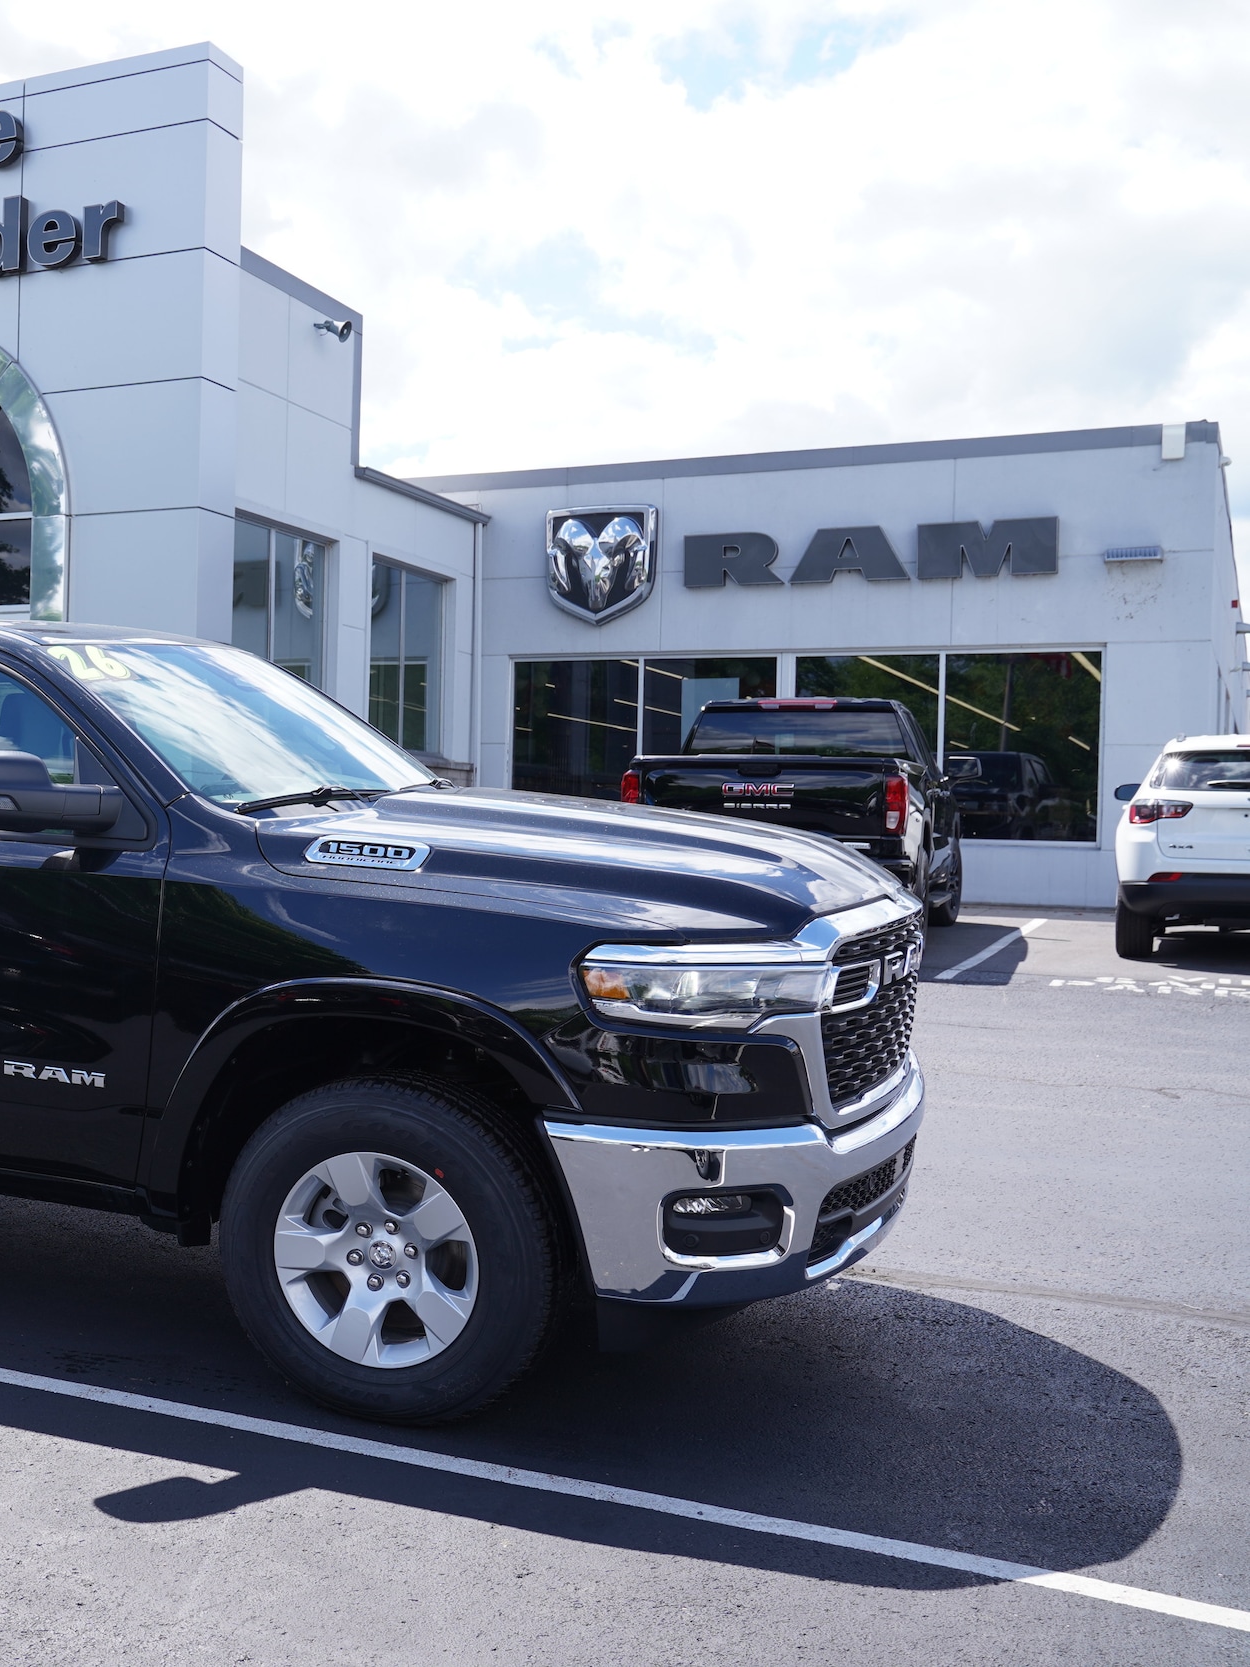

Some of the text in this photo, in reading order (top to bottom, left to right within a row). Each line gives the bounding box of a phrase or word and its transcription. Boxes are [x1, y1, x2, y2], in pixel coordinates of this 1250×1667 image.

[683, 515, 1059, 588] RAM
[46, 645, 132, 680] 26
[721, 782, 795, 797] GMC
[723, 802, 792, 810] SIERRA
[328, 841, 410, 859] 1500
[3, 1060, 106, 1088] RAM
